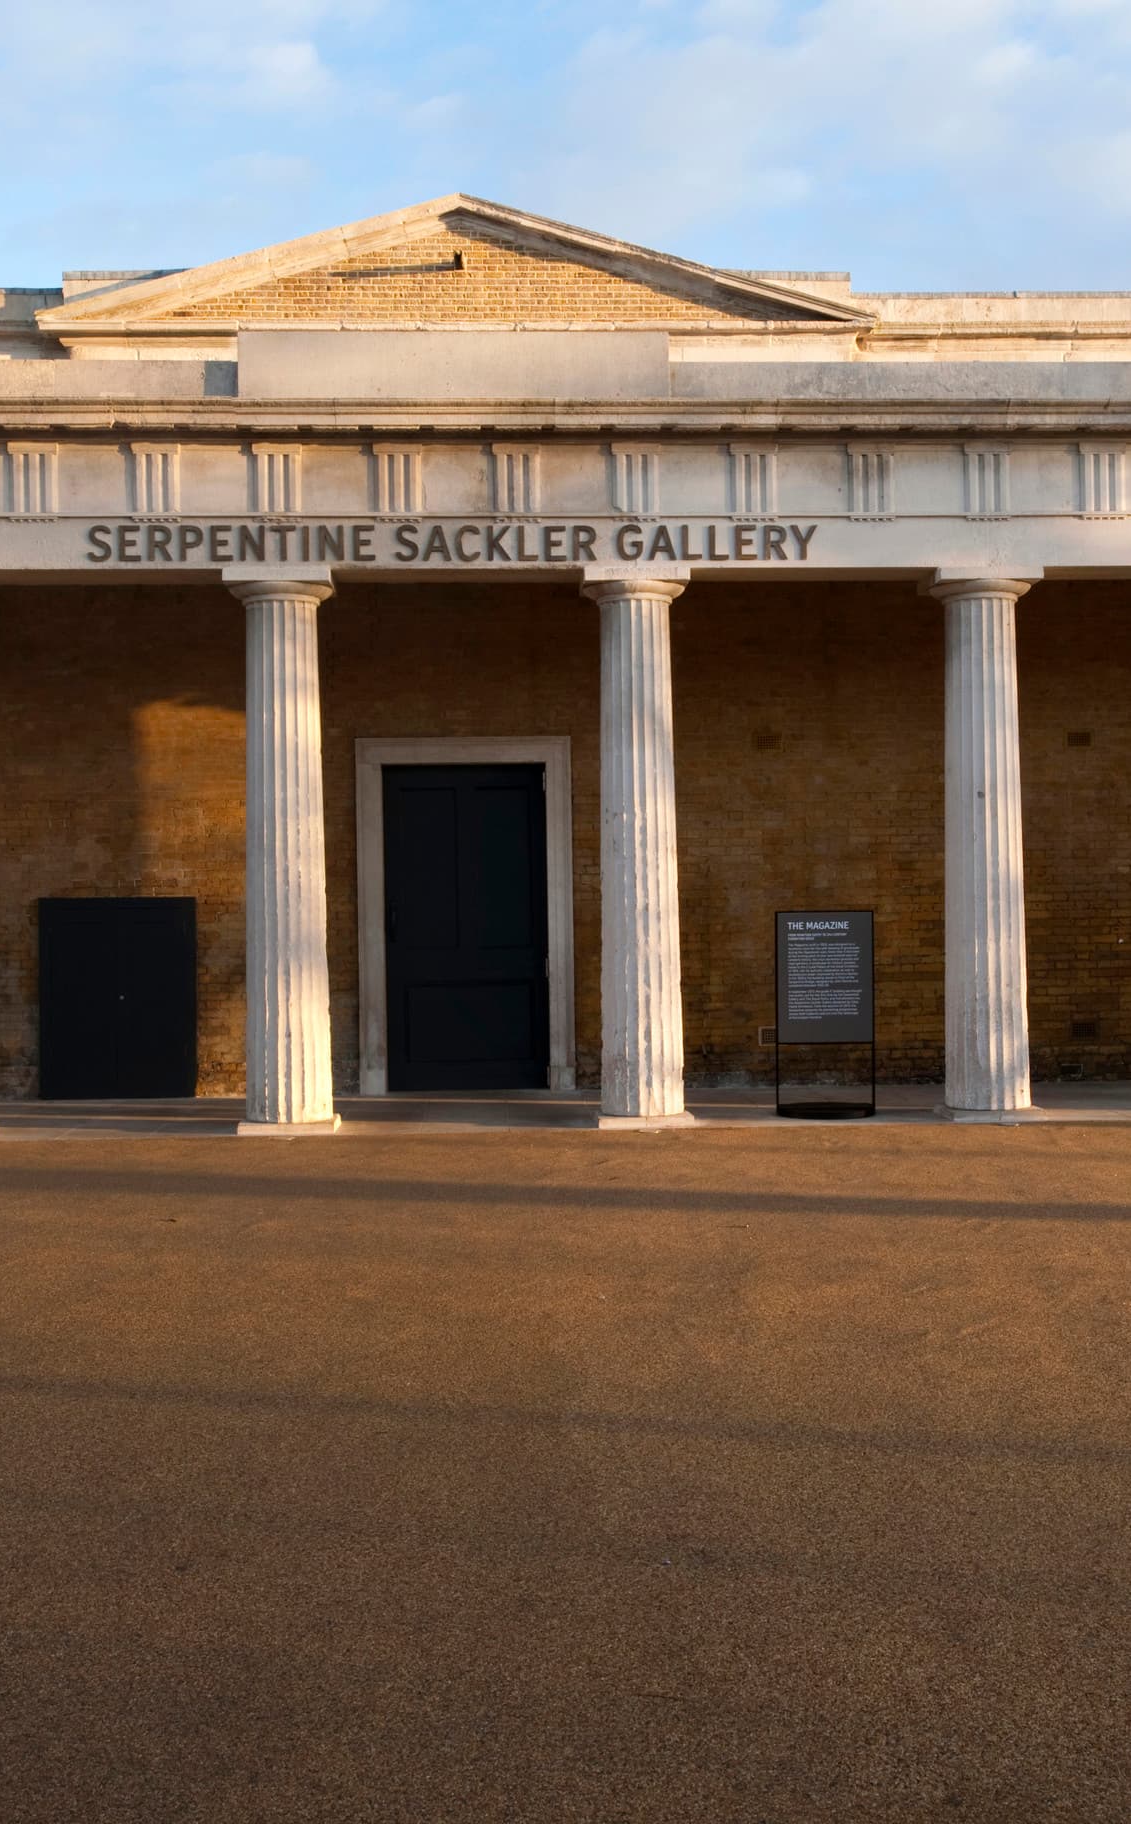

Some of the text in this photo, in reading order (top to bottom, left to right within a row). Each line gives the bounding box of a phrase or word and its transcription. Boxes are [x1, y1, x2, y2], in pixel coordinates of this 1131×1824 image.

[87, 523, 818, 563] SERPENTINE SACKLER GALLERY
[787, 920, 850, 931] THE MAGAZINE
